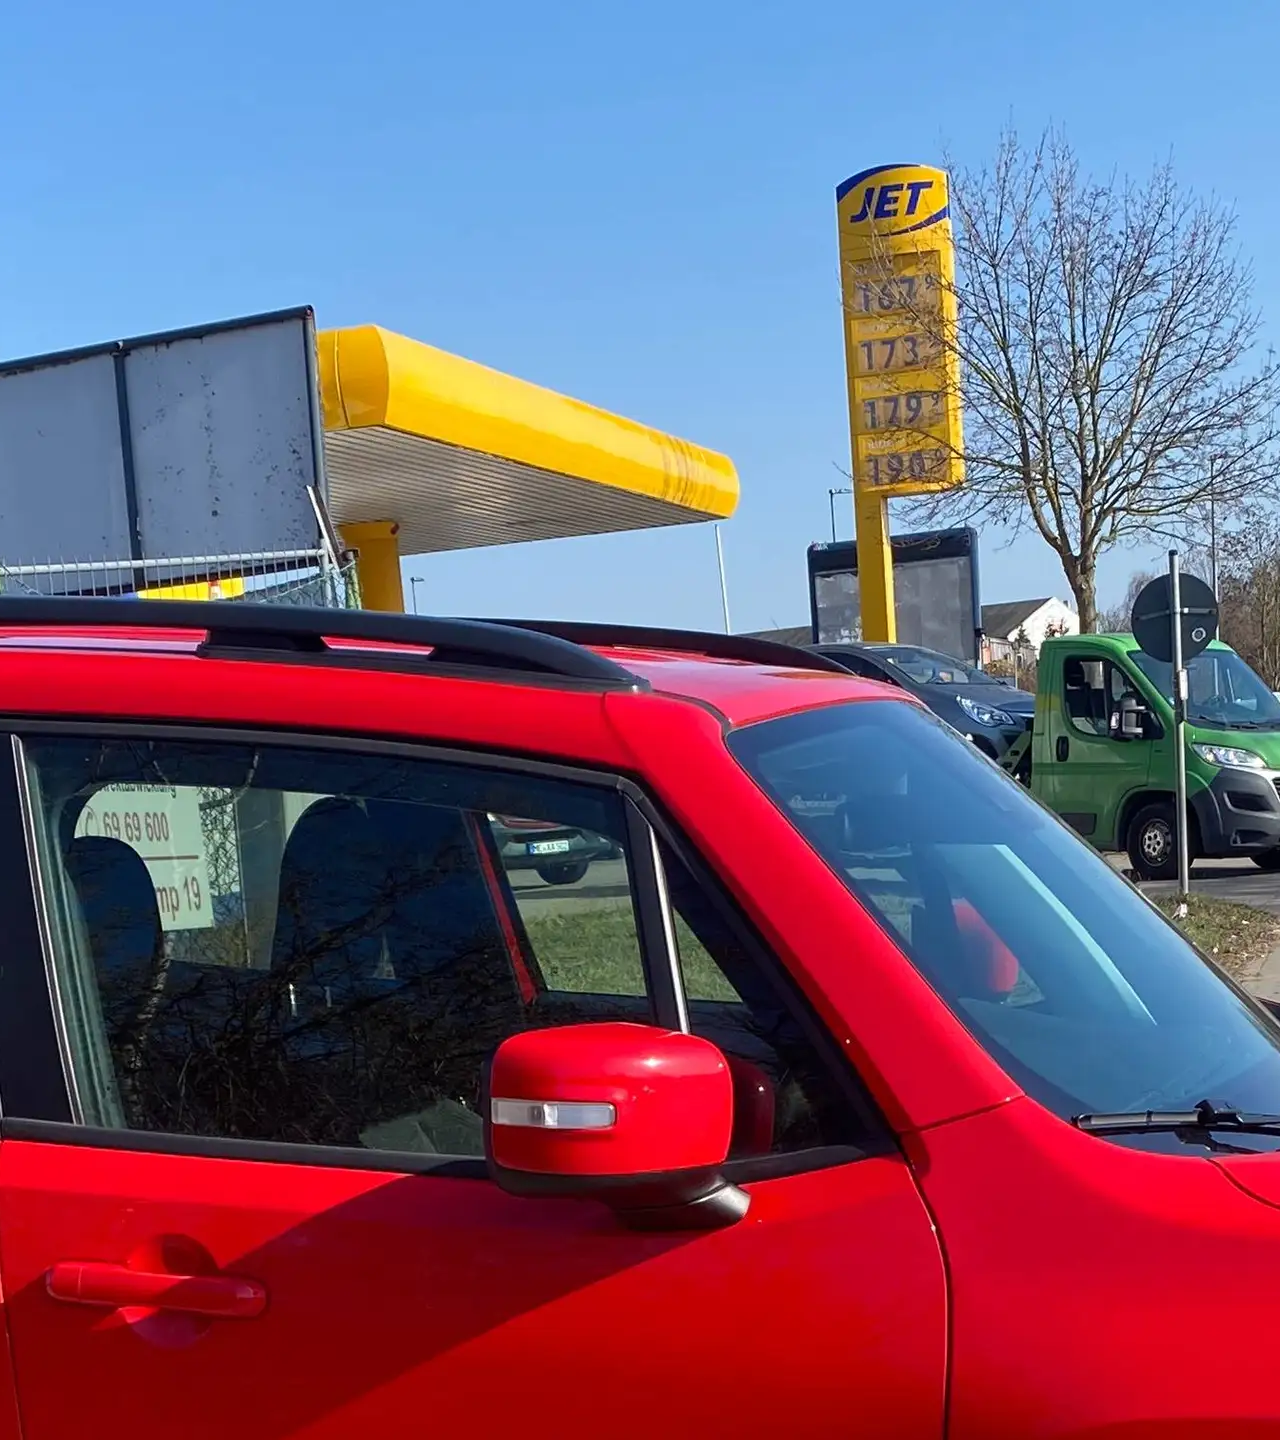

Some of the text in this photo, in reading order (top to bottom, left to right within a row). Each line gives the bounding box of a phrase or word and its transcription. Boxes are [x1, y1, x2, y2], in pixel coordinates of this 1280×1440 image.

[850, 181, 934, 223] JET
[103, 811, 169, 842] 69 69 600
[183, 876, 202, 911] 19
